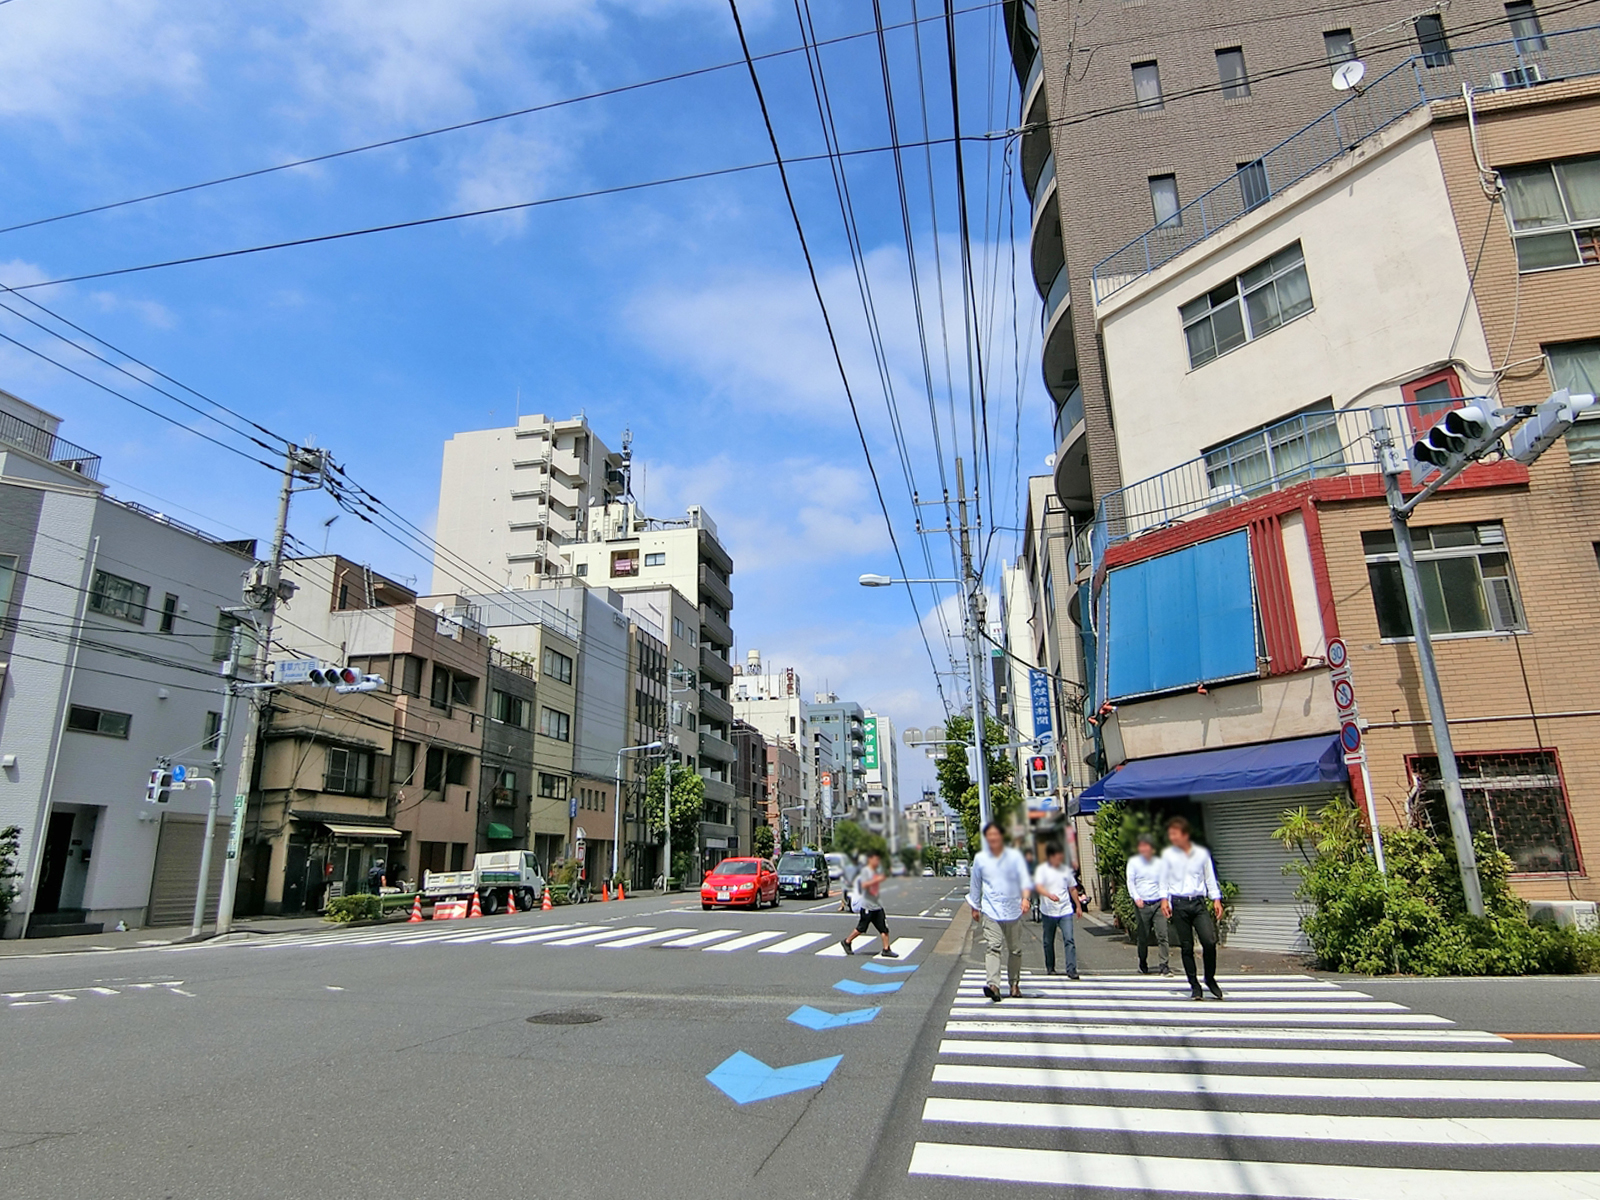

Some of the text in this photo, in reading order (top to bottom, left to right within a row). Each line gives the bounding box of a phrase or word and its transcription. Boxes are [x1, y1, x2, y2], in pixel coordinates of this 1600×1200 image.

[1331, 646, 1343, 661] 30
[279, 661, 315, 671] 浅草六丁目
[786, 667, 794, 695] HOTEL
[1032, 672, 1049, 725] 日本経済新聞
